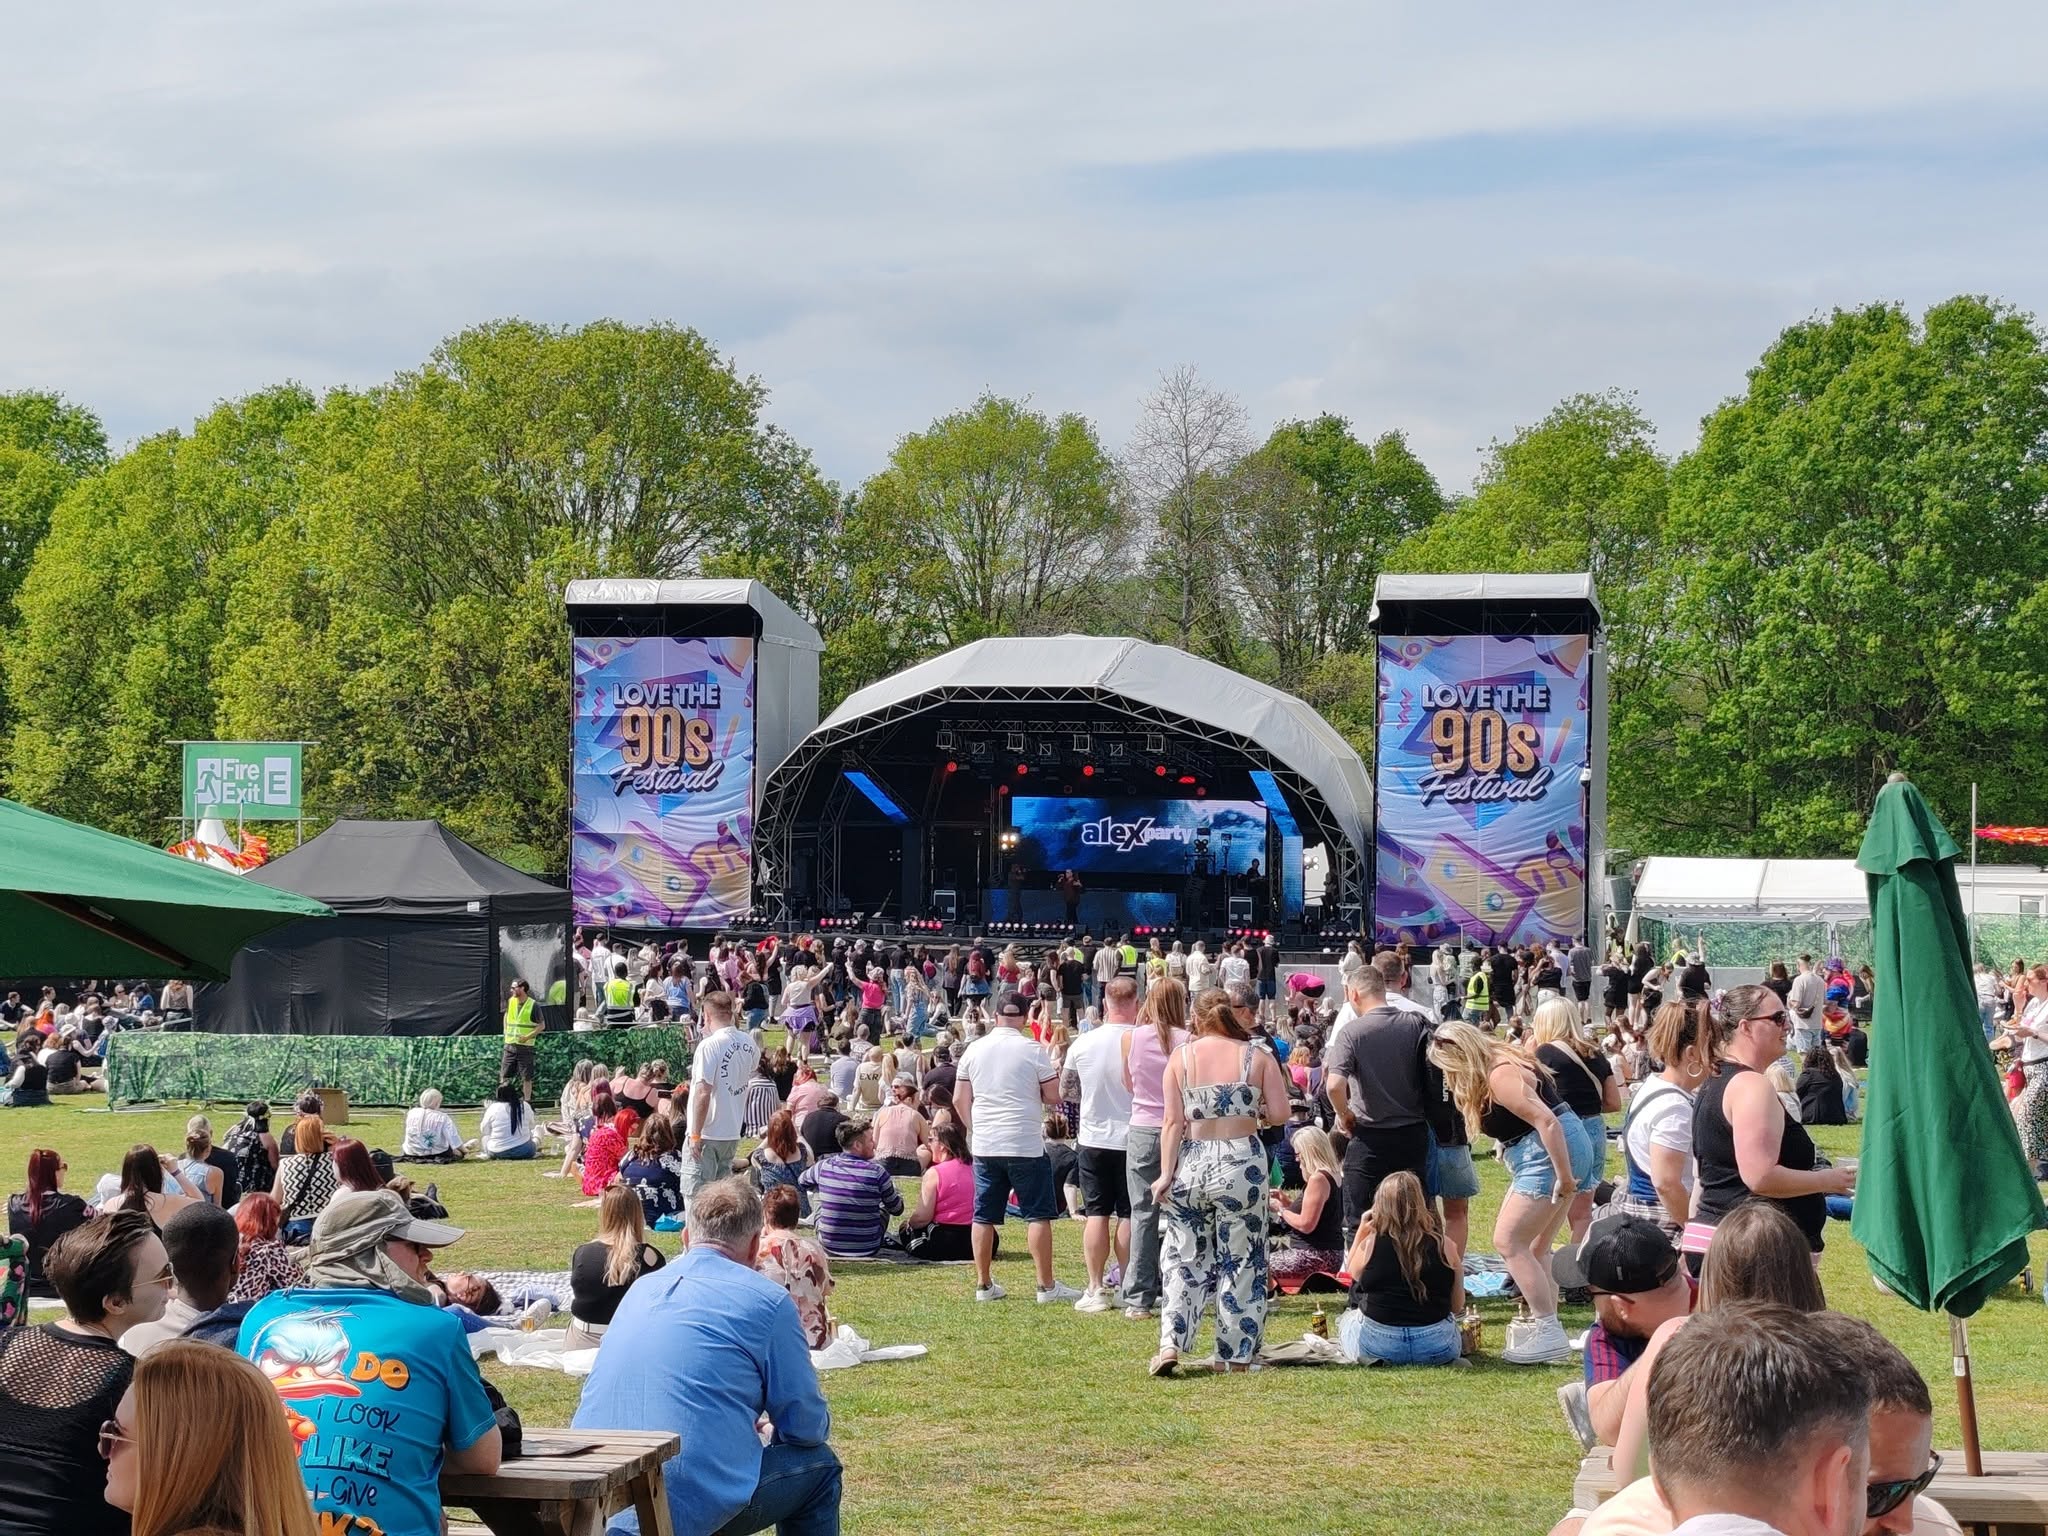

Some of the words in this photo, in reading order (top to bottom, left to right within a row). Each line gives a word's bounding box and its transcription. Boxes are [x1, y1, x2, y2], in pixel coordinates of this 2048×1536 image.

[612, 682, 676, 708] LOVE
[678, 683, 721, 709] THE
[1421, 683, 1497, 711] LOVE
[1497, 684, 1550, 713] THE
[620, 706, 713, 770] 90s
[1431, 708, 1541, 777] 90s
[222, 758, 260, 780] Fire
[268, 770, 287, 795] E
[608, 758, 725, 798] Festival
[222, 782, 261, 805] Exit
[1417, 766, 1554, 807] Festival
[1144, 824, 1193, 845] party
[350, 1352, 411, 1391] DO
[334, 1399, 401, 1433] LOOK
[303, 1433, 394, 1481] LIKE
